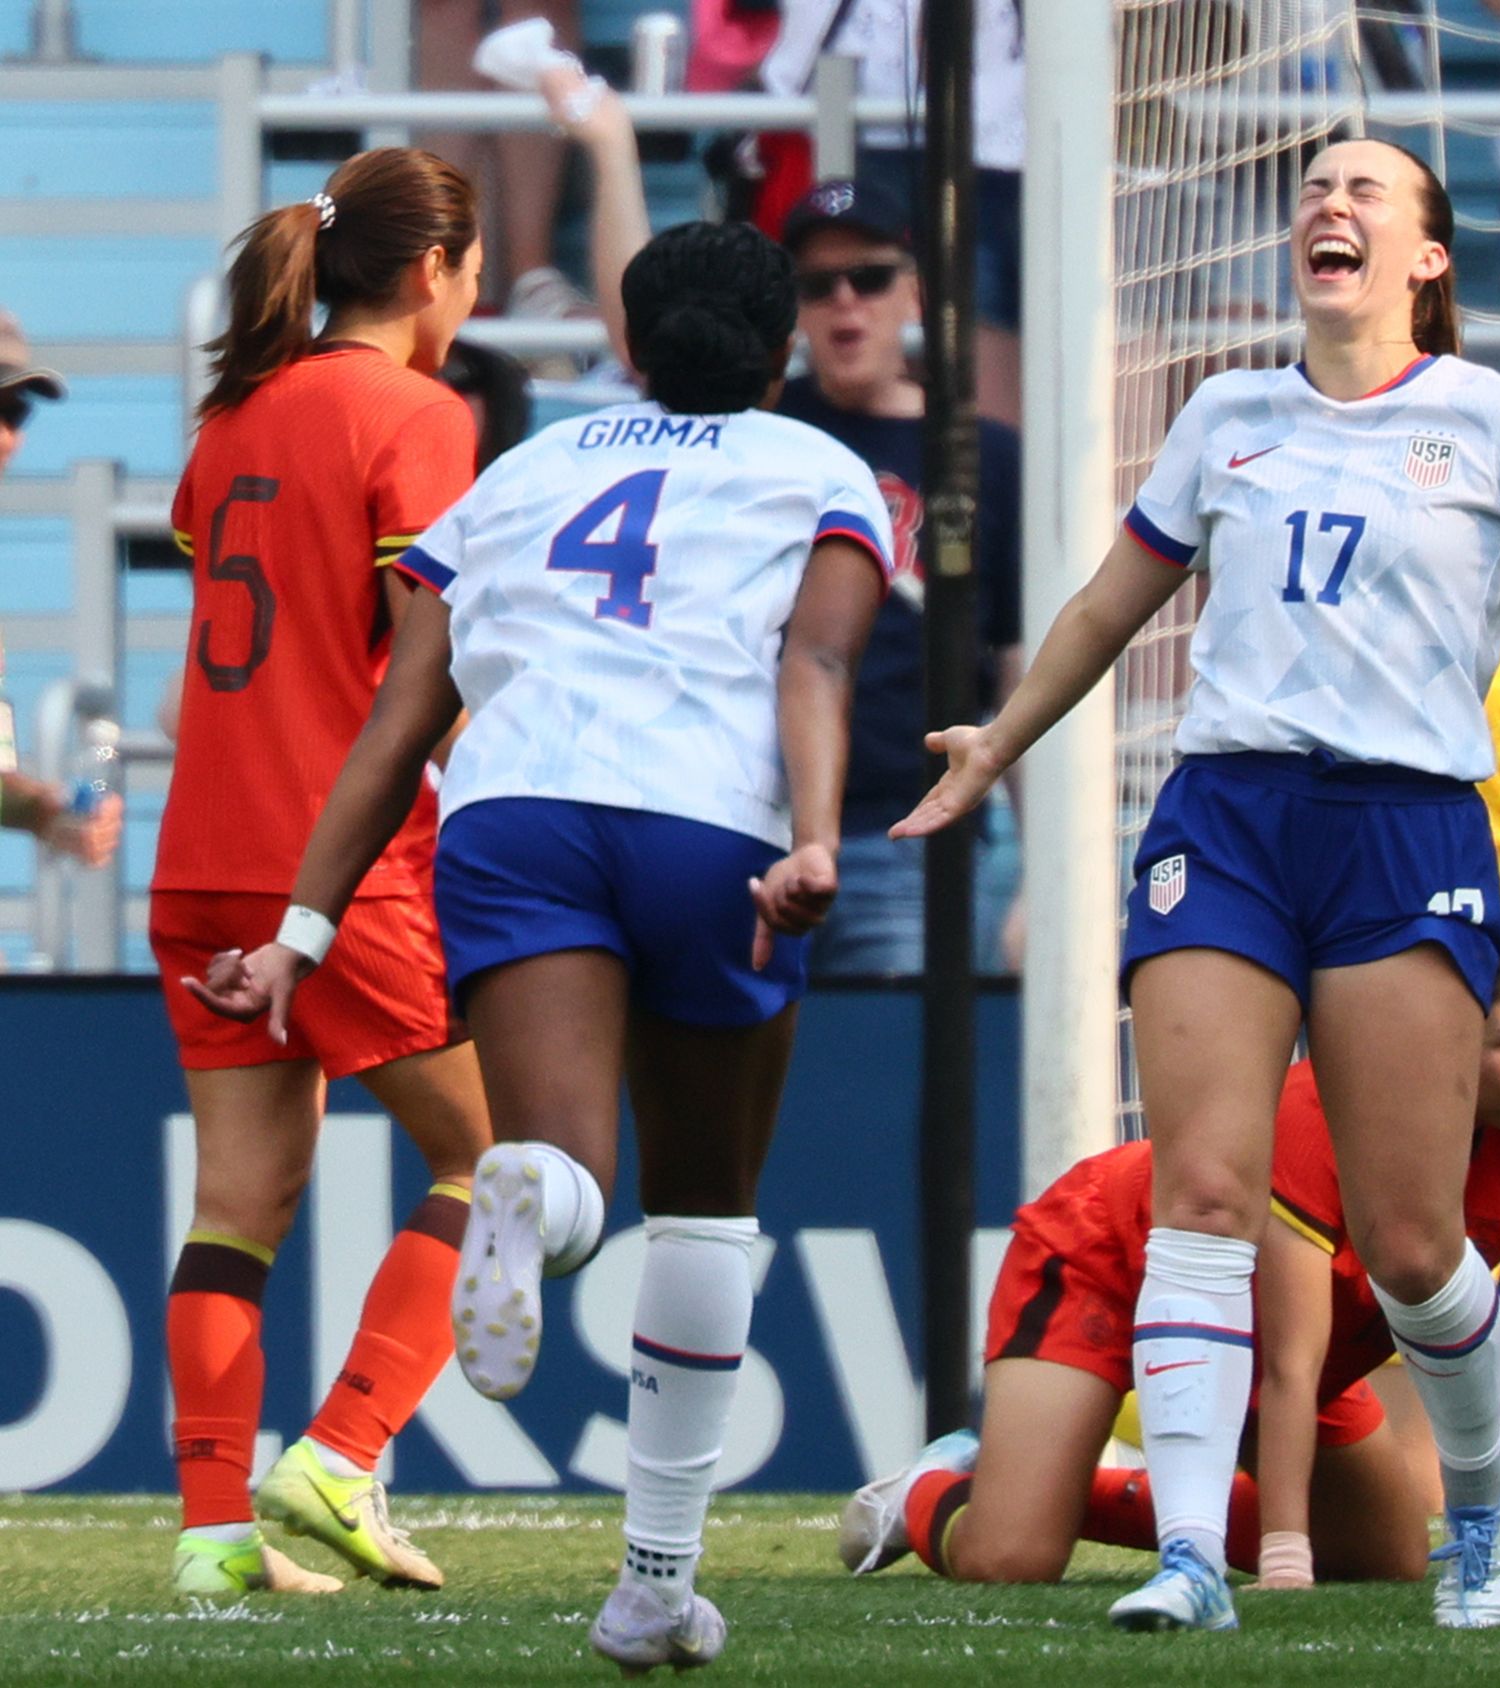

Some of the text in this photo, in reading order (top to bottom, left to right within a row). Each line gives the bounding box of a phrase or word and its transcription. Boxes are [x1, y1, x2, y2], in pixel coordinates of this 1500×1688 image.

[577, 416, 722, 450] GIRMA
[1411, 439, 1452, 463] USA
[545, 468, 670, 630] 4
[1281, 510, 1367, 607] 17
[197, 474, 281, 692] 5
[1152, 857, 1182, 883] USA
